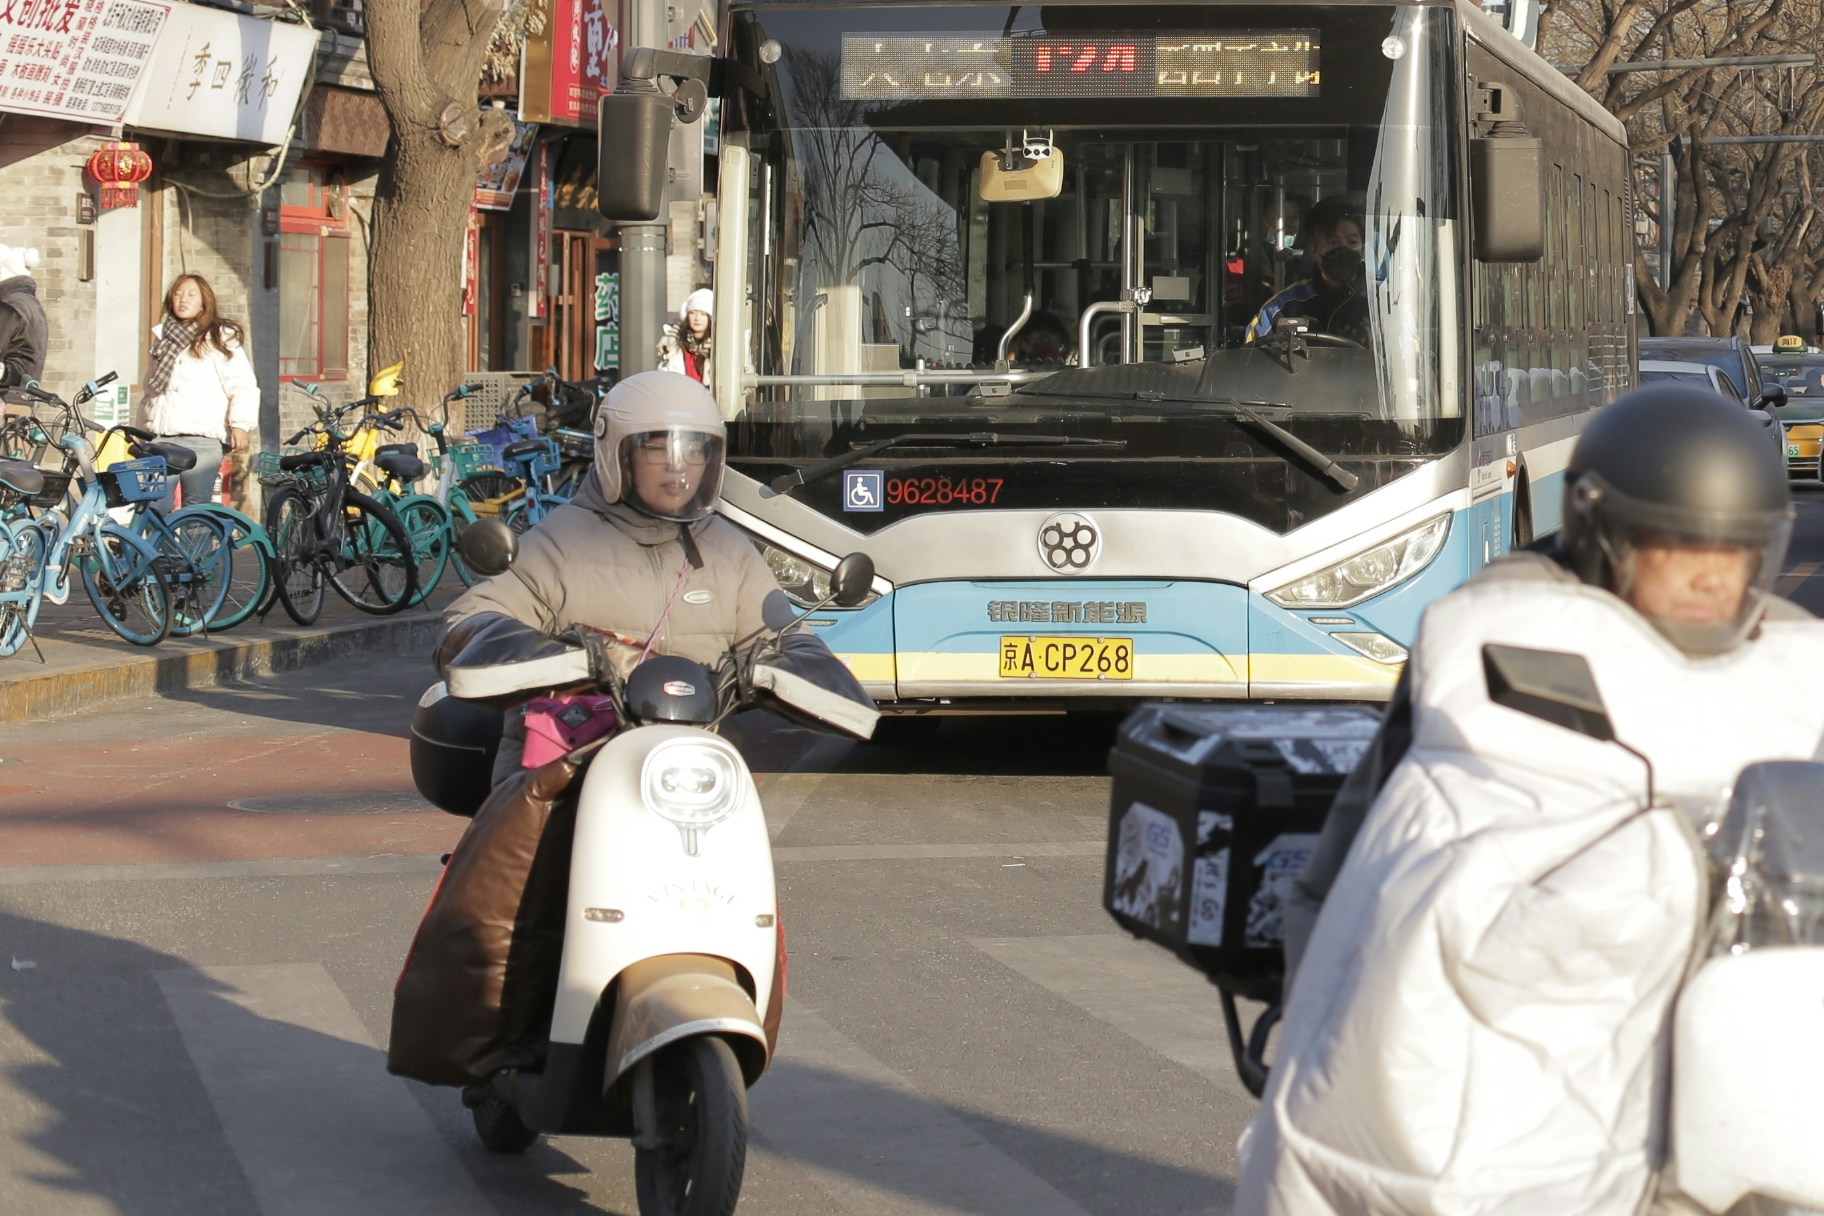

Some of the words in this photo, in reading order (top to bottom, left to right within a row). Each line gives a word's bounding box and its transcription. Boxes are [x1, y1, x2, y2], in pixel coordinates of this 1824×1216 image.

[594, 272, 619, 370] 药店
[886, 478, 1004, 504] 9628487
[987, 600, 1147, 624] 银隆新能源
